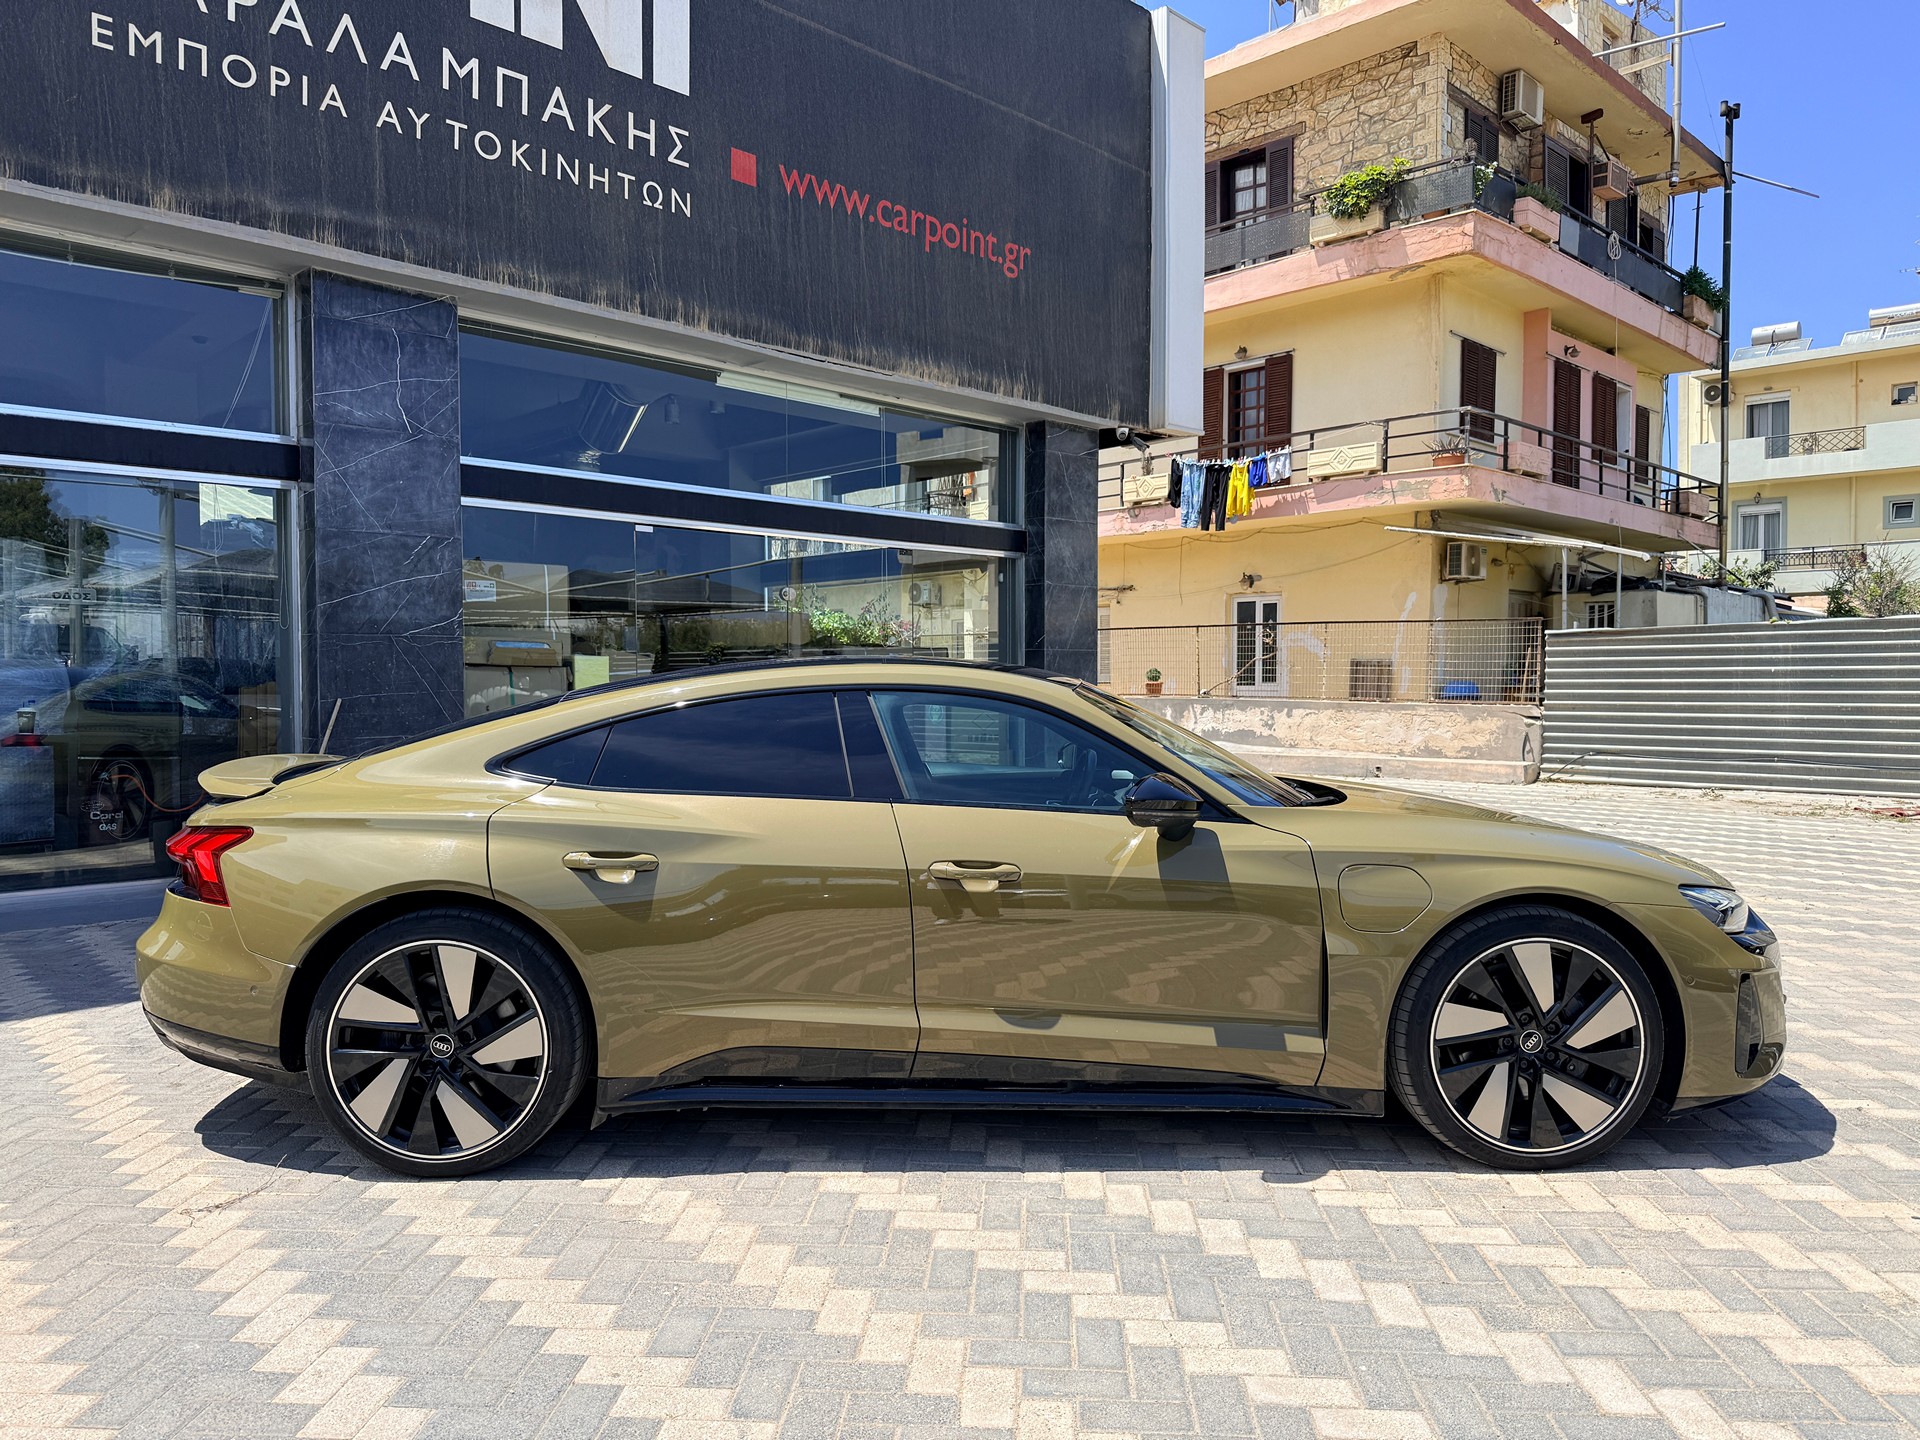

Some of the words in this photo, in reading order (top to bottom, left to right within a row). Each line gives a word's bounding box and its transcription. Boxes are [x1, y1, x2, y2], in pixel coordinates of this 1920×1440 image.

[91, 12, 348, 118] ΕΜΠΟΡΙΑ
[376, 101, 691, 218] ΑΥΤΟΚΙΝΗΤΩΝ
[199, 0, 690, 168] ΑΛΑΜΠΑΚΗΣ
[779, 164, 1031, 278] www.carpoint.gr
[90, 811, 124, 820] Coral
[99, 823, 118, 831] GAS
